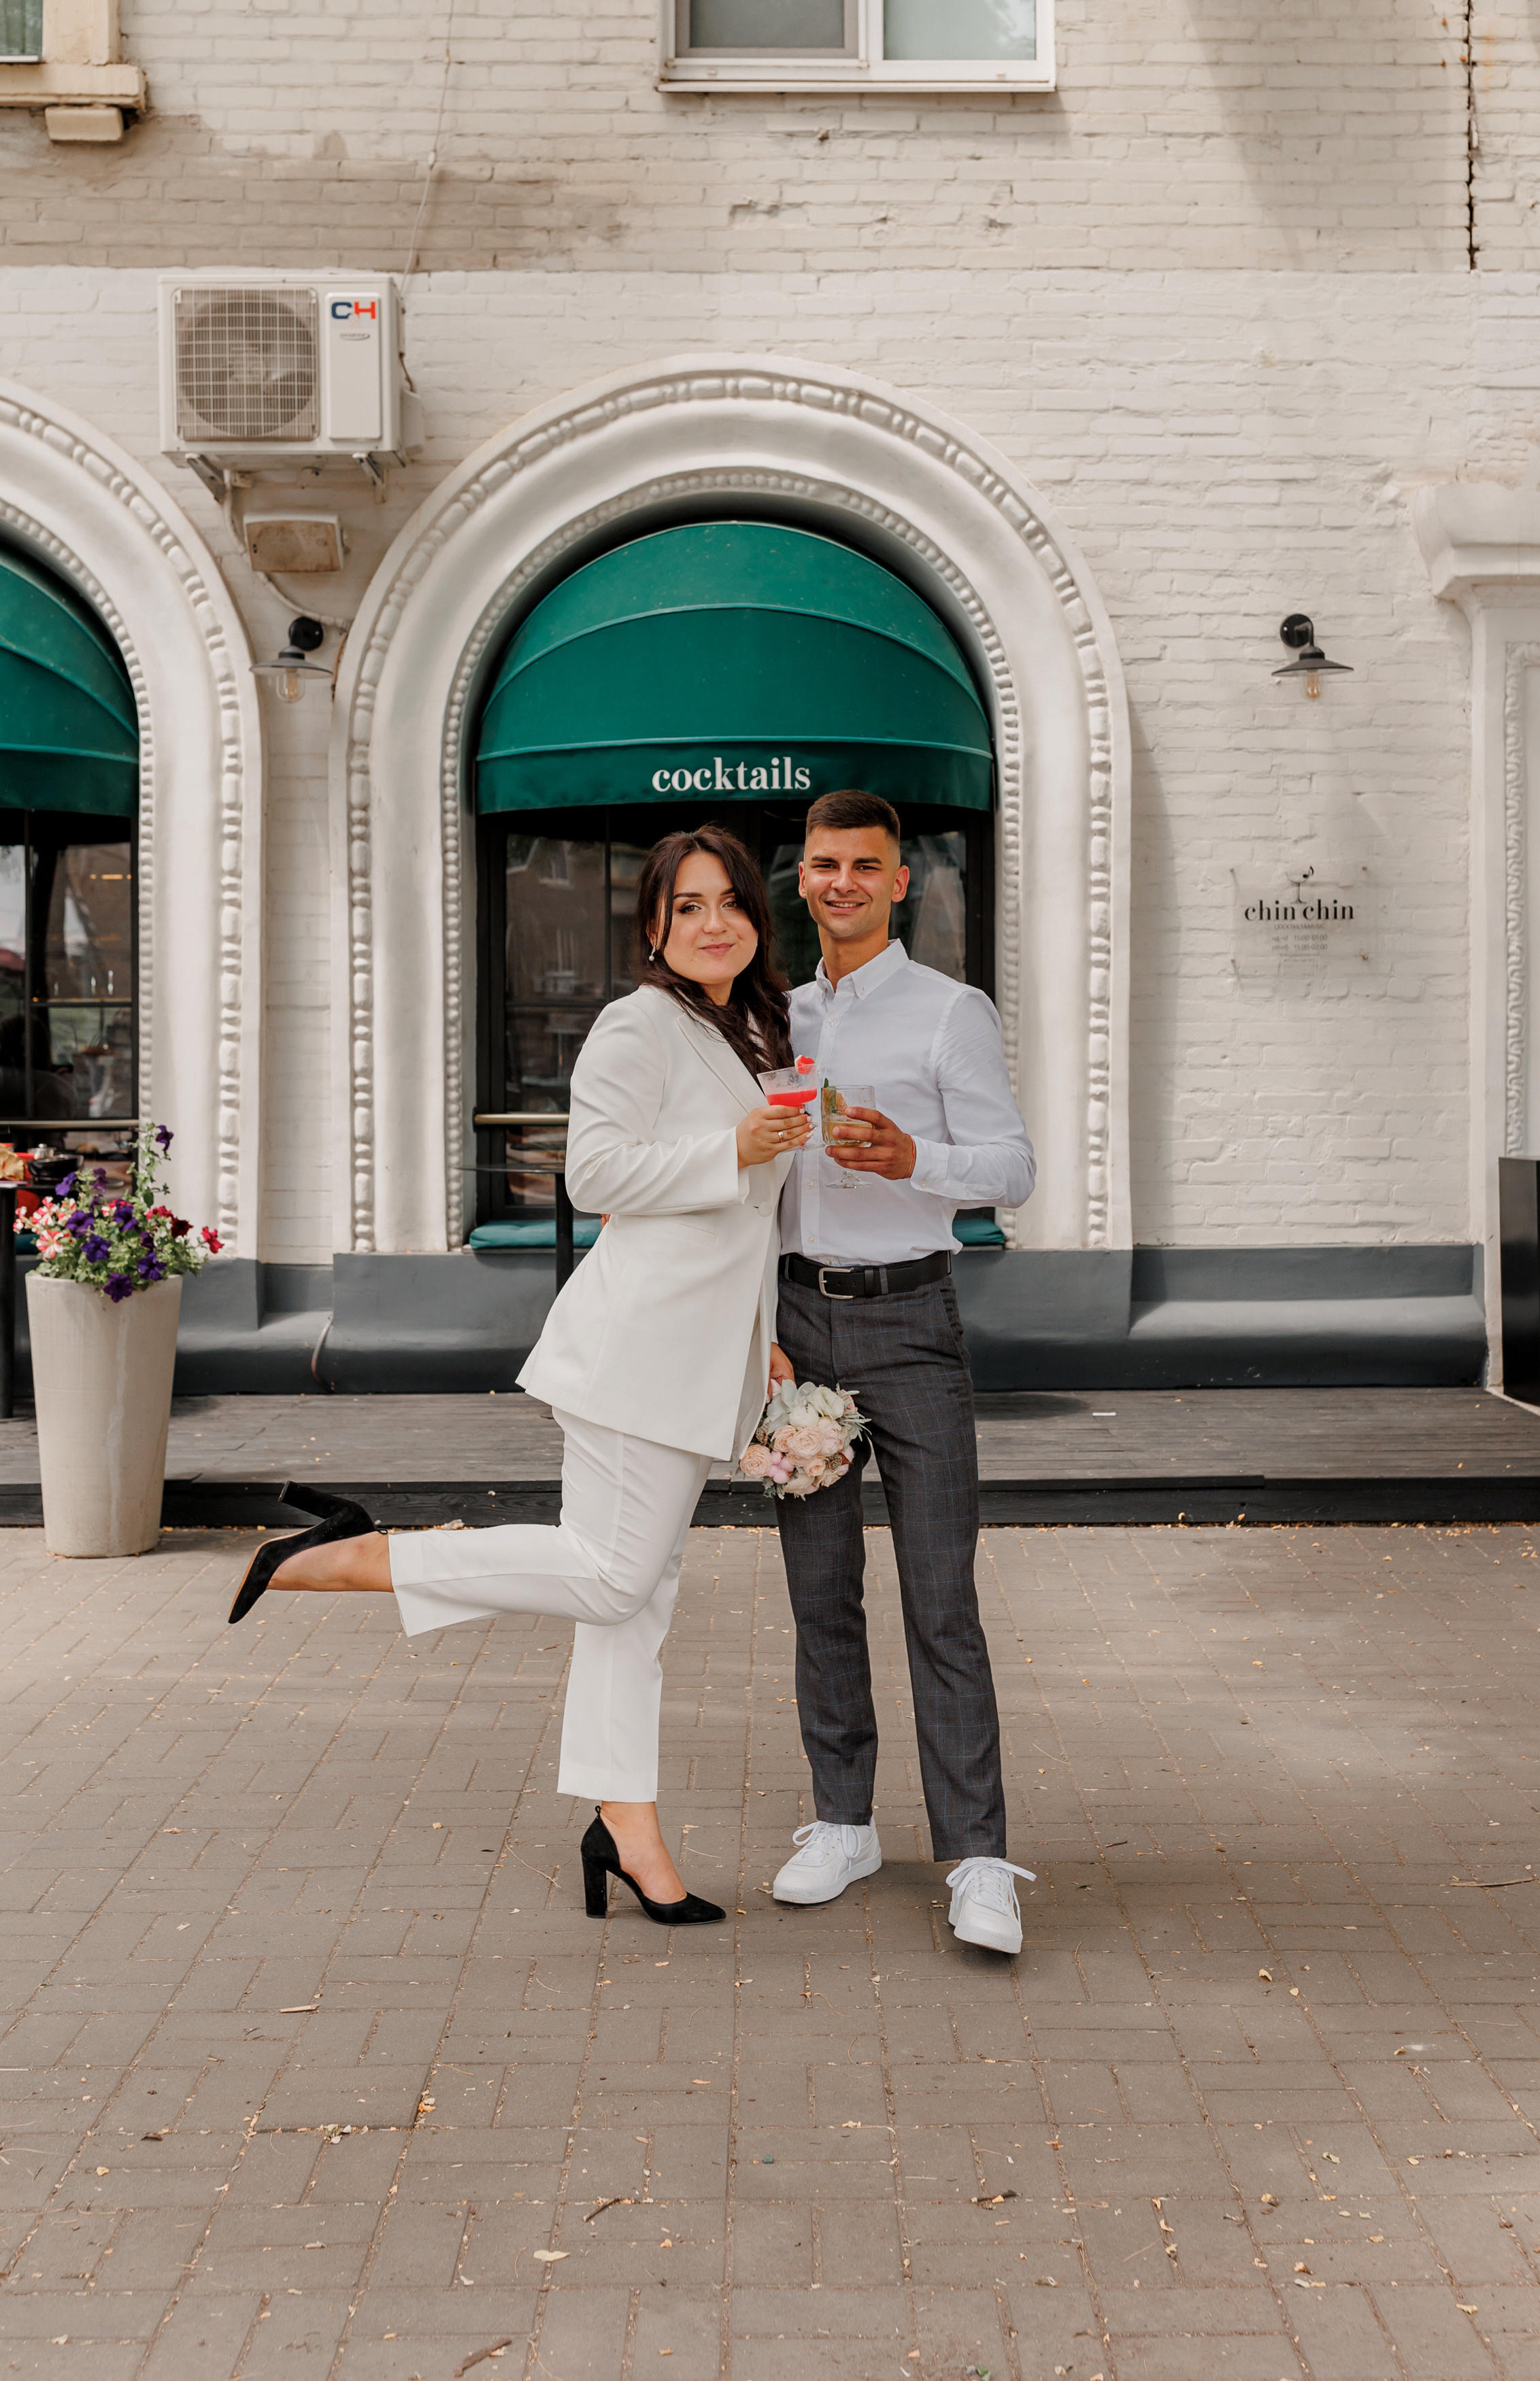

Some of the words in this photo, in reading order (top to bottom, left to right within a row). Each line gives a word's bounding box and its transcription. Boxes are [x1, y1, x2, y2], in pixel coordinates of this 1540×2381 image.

[331, 301, 376, 320] CH
[652, 756, 811, 792] cocktails
[1244, 899, 1296, 921] chin
[1303, 899, 1354, 920] chin
